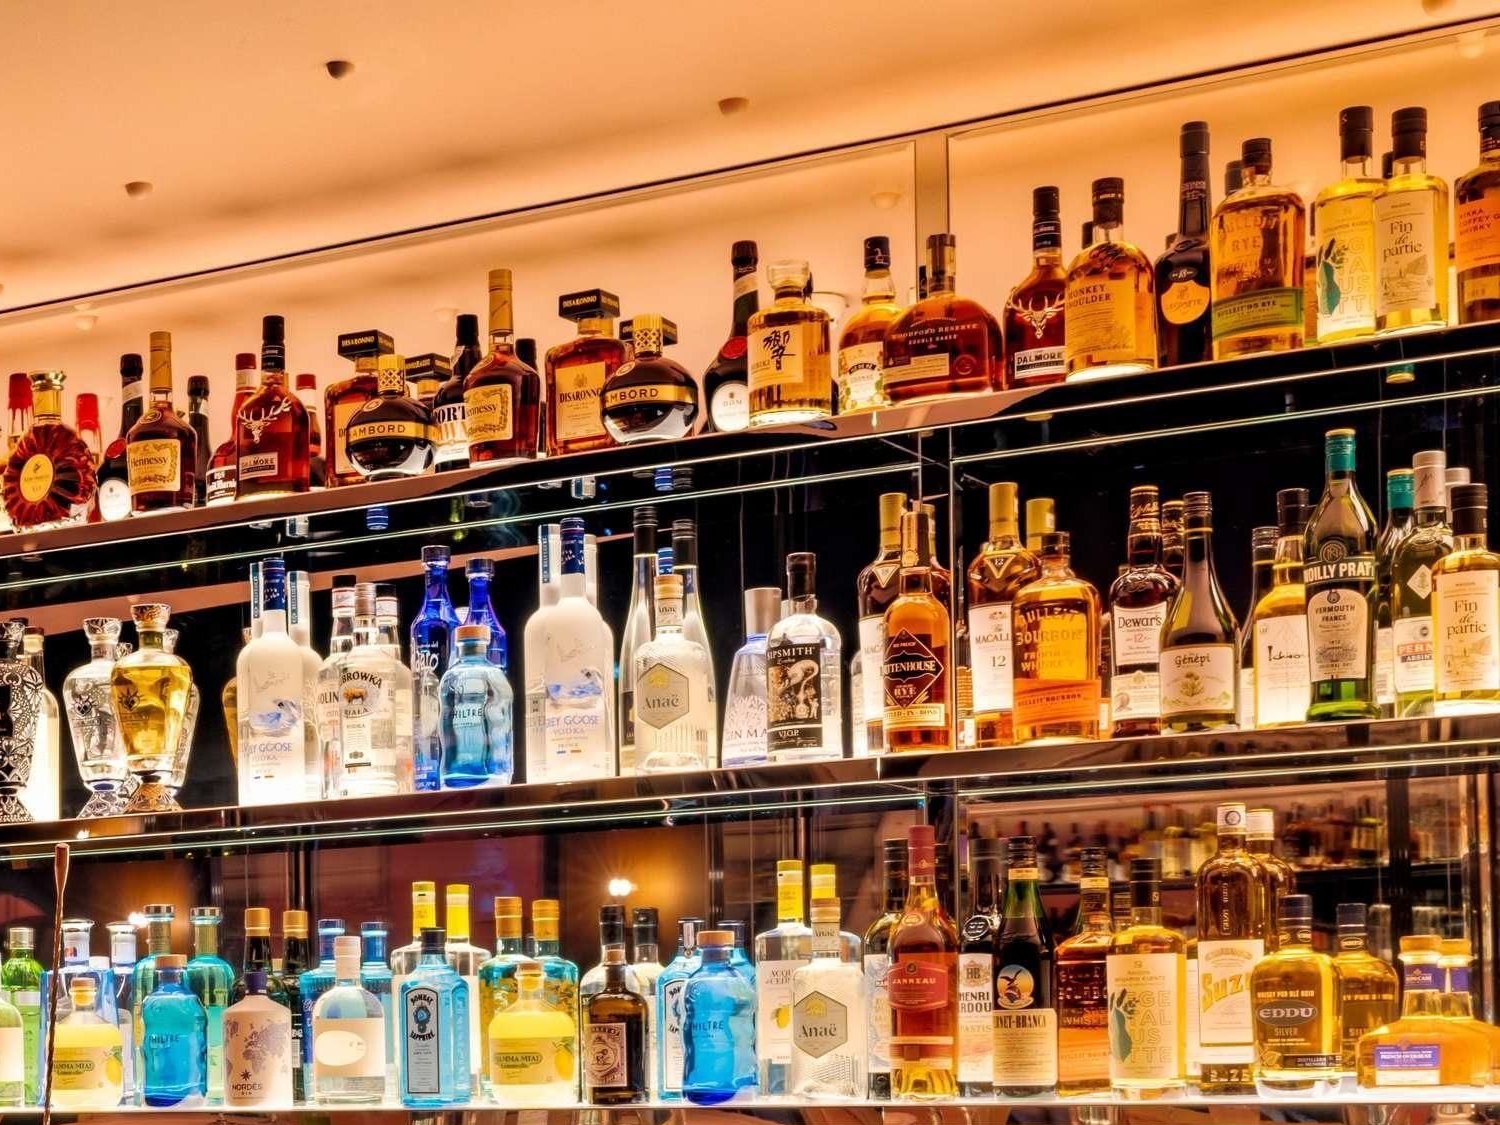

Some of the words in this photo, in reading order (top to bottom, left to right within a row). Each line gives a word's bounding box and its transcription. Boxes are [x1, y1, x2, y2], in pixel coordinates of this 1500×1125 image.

[1390, 220, 1413, 235] Fin
[1394, 233, 1408, 245] de
[1383, 242, 1422, 262] partie
[1016, 351, 1063, 365] DALMORE
[467, 404, 497, 417] ennessy
[350, 423, 406, 437] AMBORD
[130, 454, 169, 468] Hennessy
[1315, 604, 1356, 614] VERMOUTH
[1454, 600, 1478, 612] Fin
[1118, 613, 1162, 629] Dewar's
[1460, 612, 1473, 624] de
[1446, 621, 1488, 640] partie
[975, 633, 1011, 645] MACALL
[1399, 643, 1432, 655] PERN
[991, 655, 1006, 667] 12
[1404, 653, 1432, 663] ABSIN
[894, 685, 917, 696] RYE
[643, 695, 680, 710] Anaë
[451, 707, 482, 718] HILTRE
[563, 715, 599, 726] GOOSE
[746, 728, 767, 740] MA
[813, 927, 836, 938] Anaë
[892, 977, 937, 985] JANNEAU
[410, 993, 434, 1005] BOMBAY
[959, 990, 990, 1002] HENRI
[1258, 1006, 1316, 1019] EDDU
[692, 1019, 724, 1031] HILTRE
[993, 1014, 1047, 1029] RNET-BRANCA
[409, 1030, 436, 1041] SAPPHIRE
[799, 1024, 837, 1039] Anaë
[1274, 1027, 1298, 1037] SILVER
[231, 1081, 263, 1091] NORDÉS
